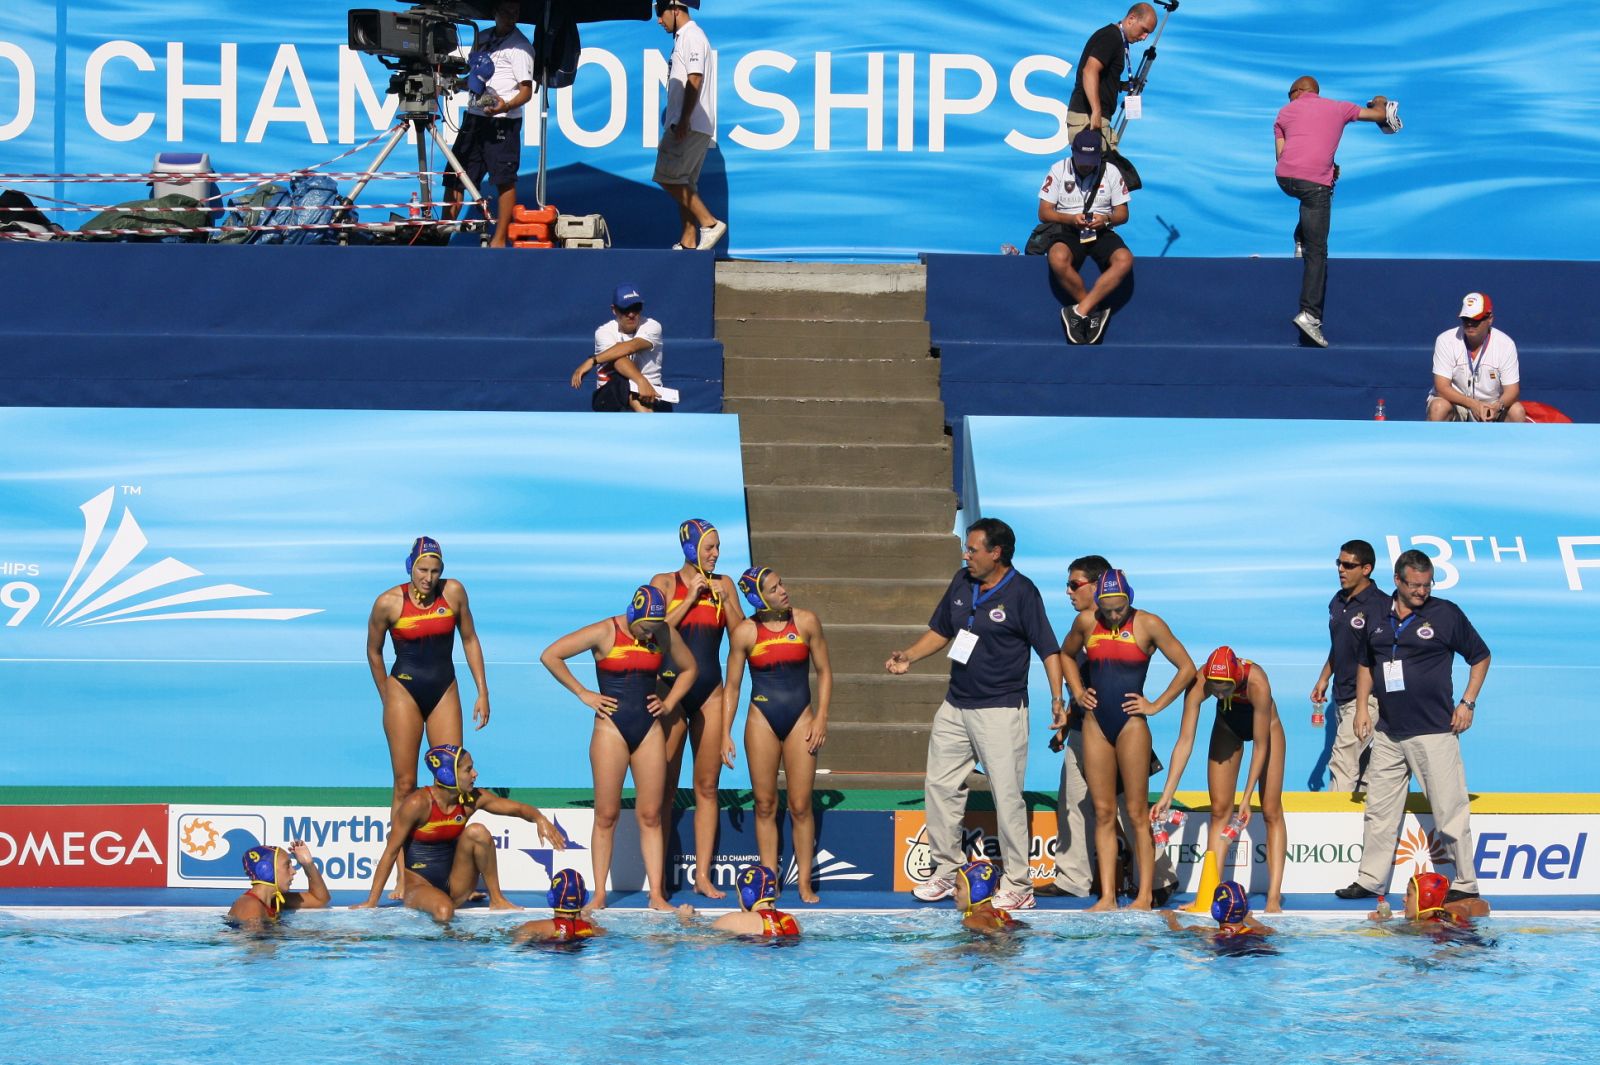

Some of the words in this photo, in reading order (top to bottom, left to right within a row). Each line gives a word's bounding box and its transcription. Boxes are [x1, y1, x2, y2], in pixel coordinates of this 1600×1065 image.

[120, 485, 142, 495] TM
[1103, 580, 1118, 588] ESP
[651, 604, 665, 612] ESP
[429, 755, 441, 768] 8
[283, 815, 392, 847] Myrth
[249, 851, 261, 862] 9
[1255, 843, 1364, 864] SNPAOLO
[1474, 832, 1588, 880] Enel
[744, 869, 755, 884] 5
[980, 865, 993, 880] 3
